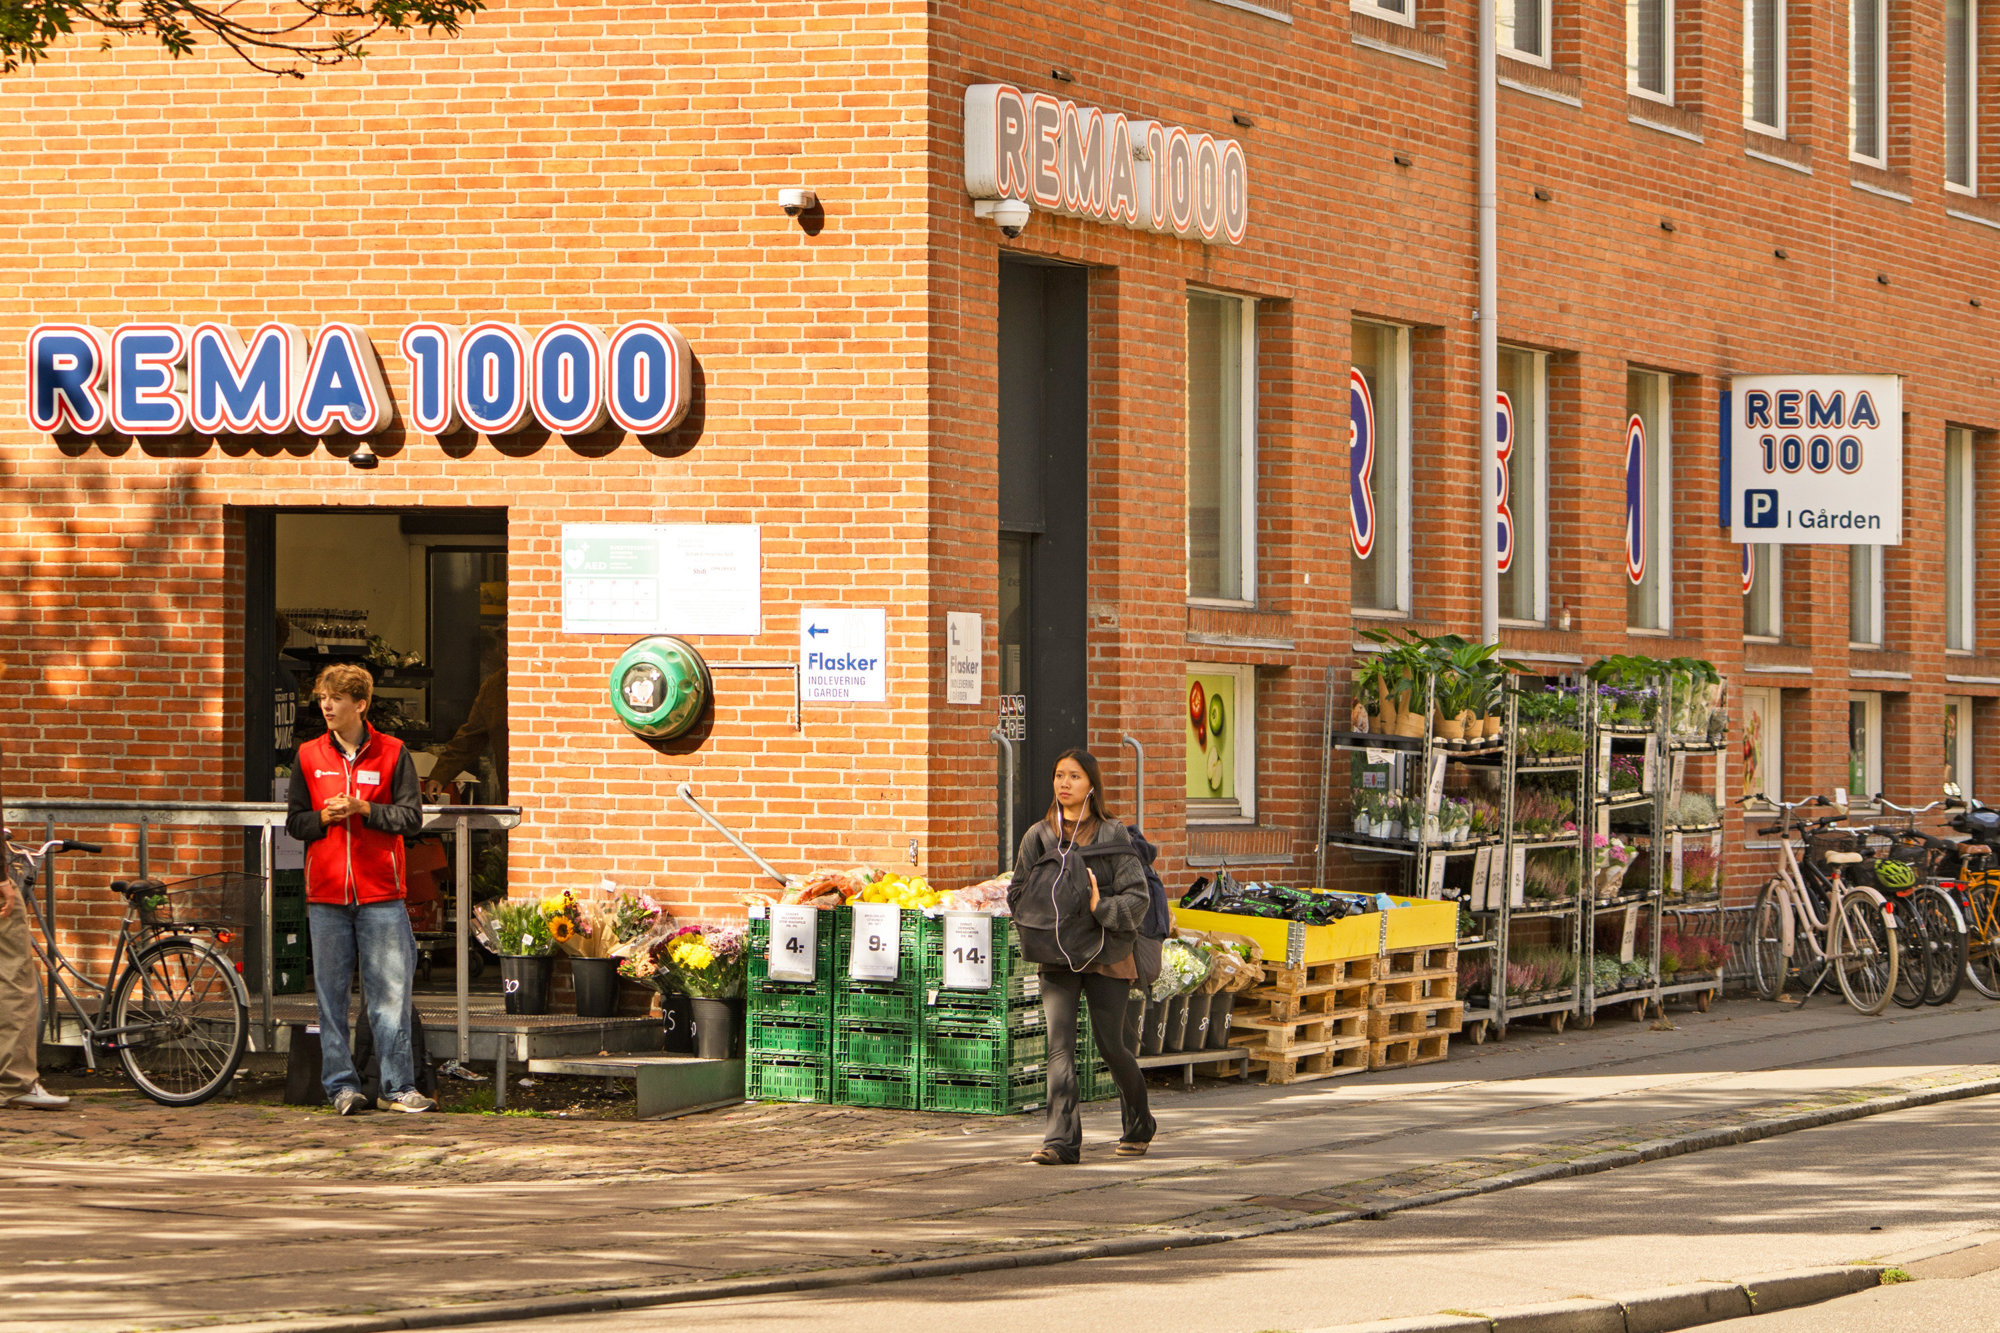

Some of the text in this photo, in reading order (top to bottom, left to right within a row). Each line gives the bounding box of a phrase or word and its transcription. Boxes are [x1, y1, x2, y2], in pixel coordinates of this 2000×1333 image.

[996, 83, 1247, 245] REMA 1000
[26, 320, 679, 436] REMA 1000
[1745, 389, 1880, 430] REMA
[1759, 434, 1863, 475] 1000
[1752, 493, 1772, 524] P
[1799, 508, 1880, 529] Gården
[808, 652, 877, 671] Flasker
[950, 655, 978, 675] Flasker
[808, 676, 866, 686] INDLEVERING
